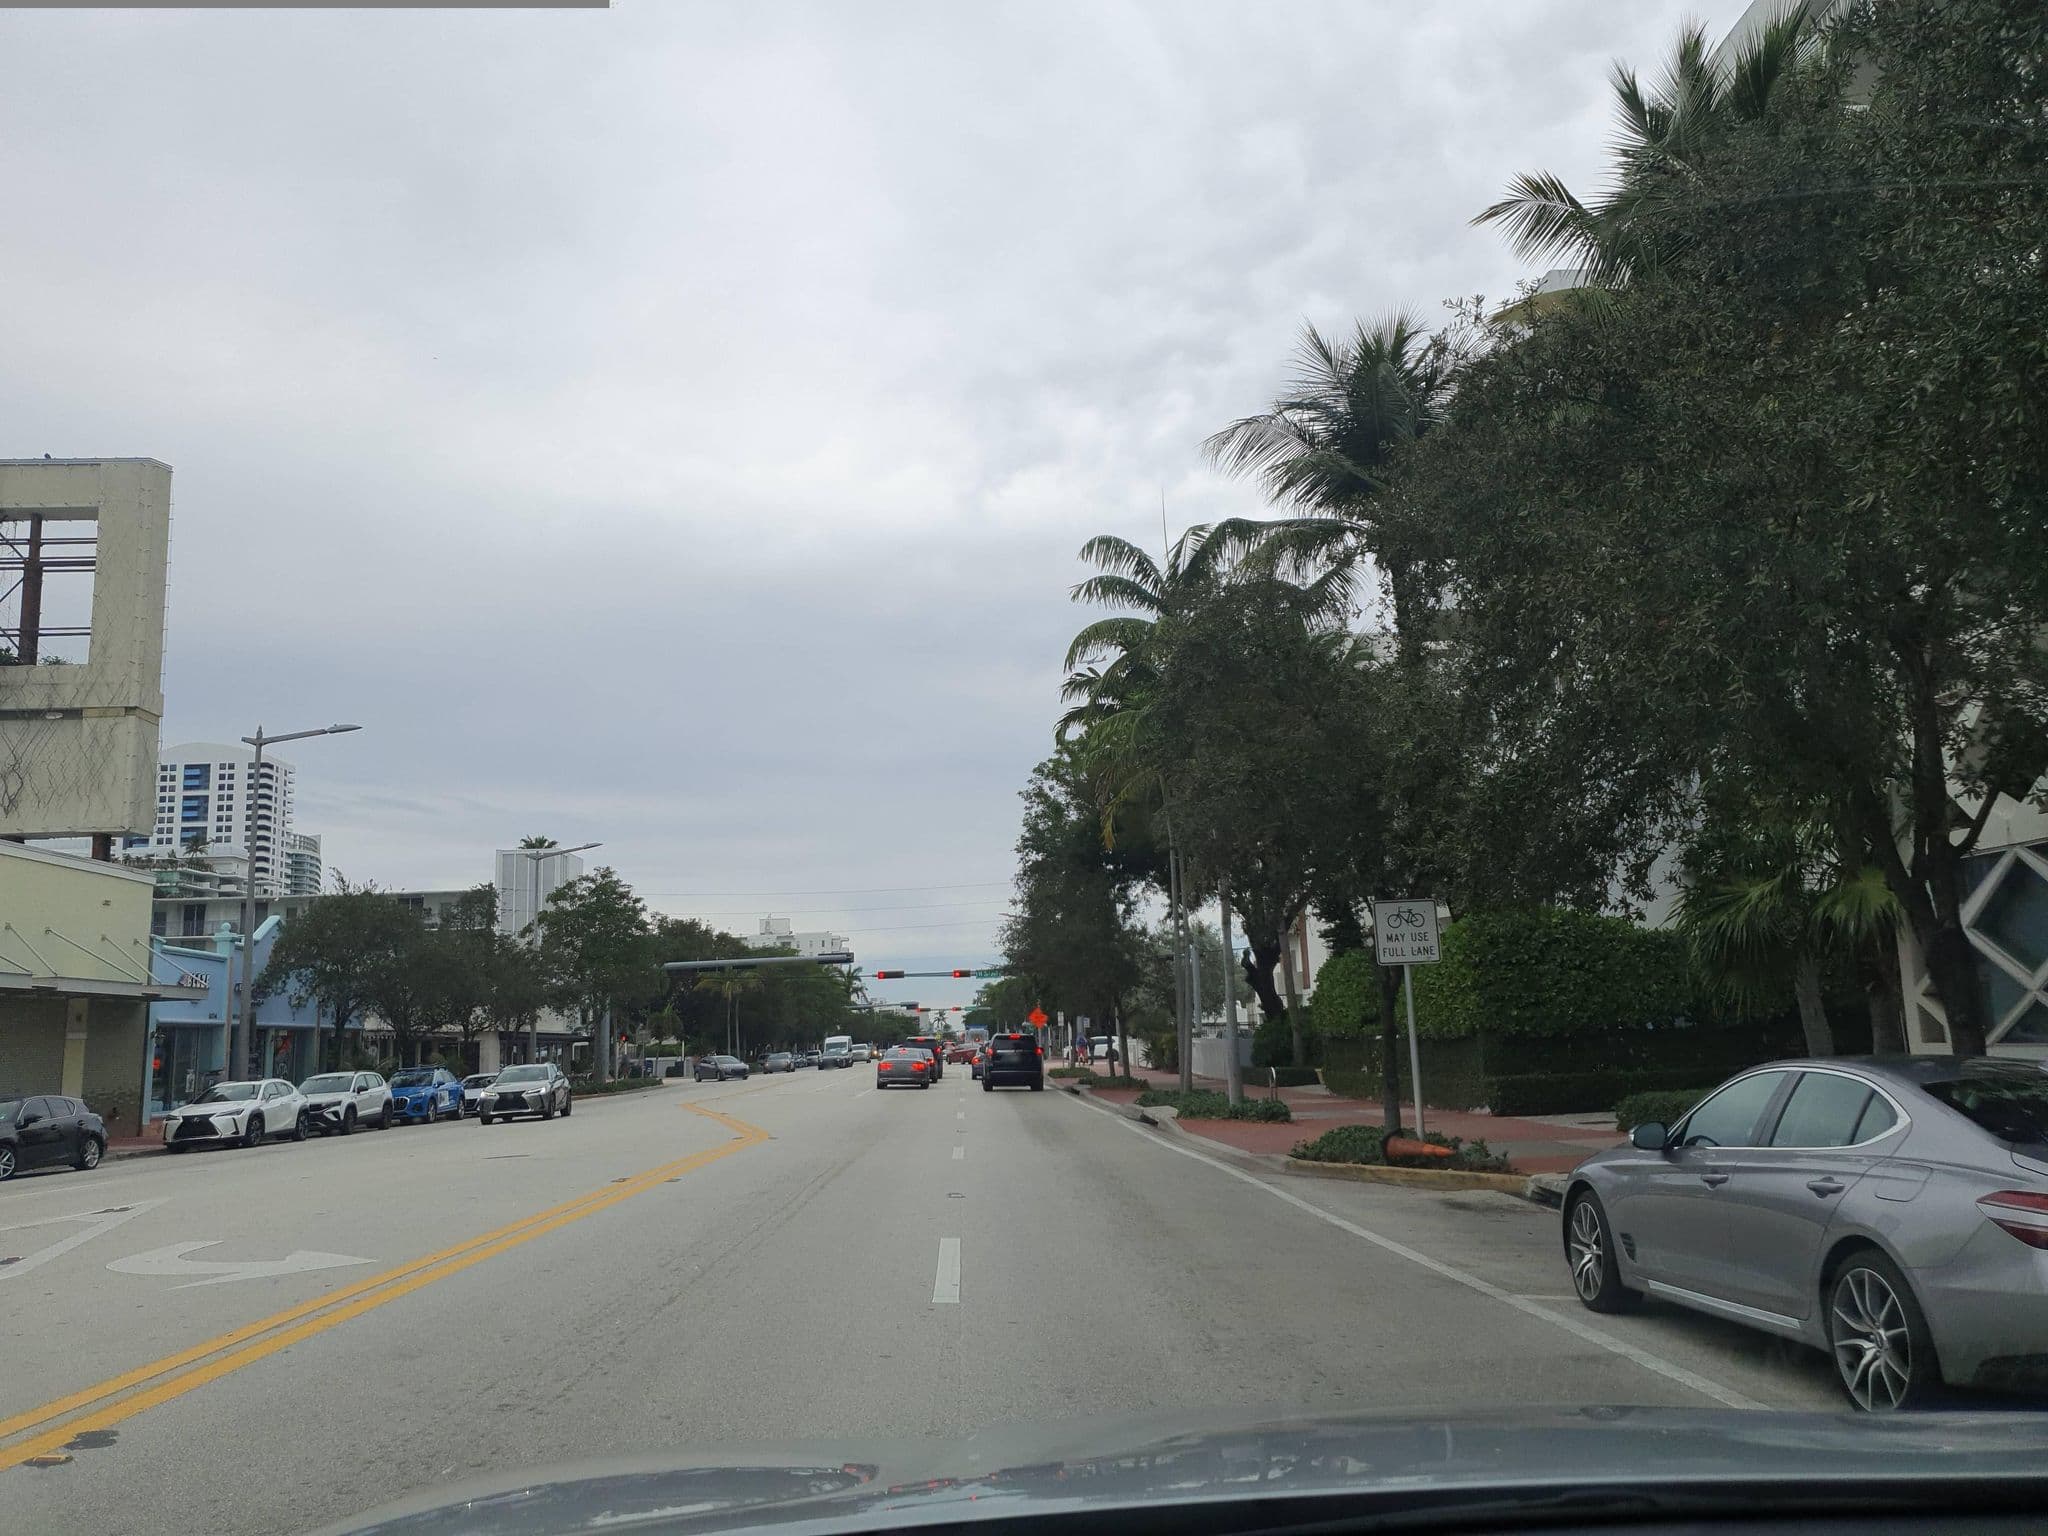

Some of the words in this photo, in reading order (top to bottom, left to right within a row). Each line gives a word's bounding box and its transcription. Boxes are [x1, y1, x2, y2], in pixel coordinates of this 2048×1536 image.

[1386, 932, 1406, 943] MAY
[1411, 931, 1429, 942] USE
[1383, 947, 1406, 957] FULL
[1411, 946, 1436, 956] LANE
